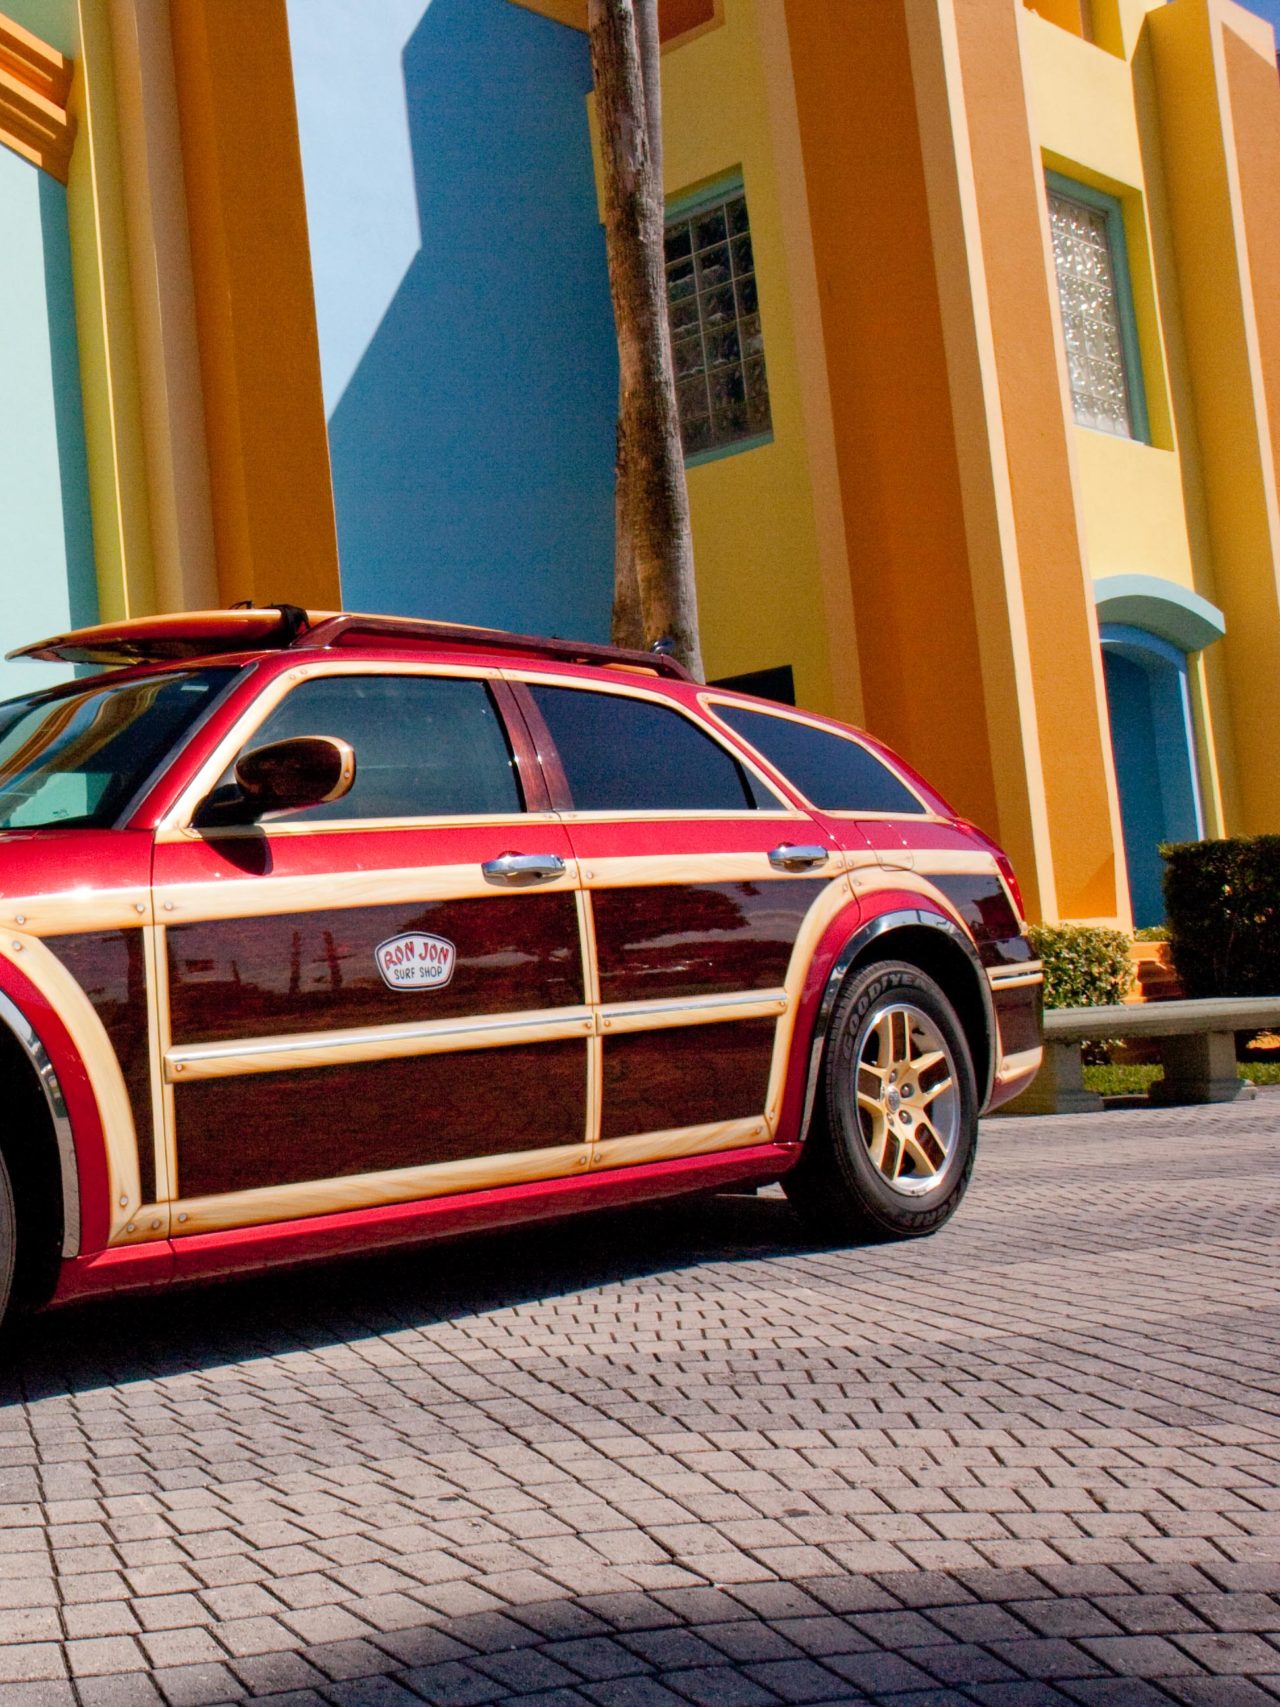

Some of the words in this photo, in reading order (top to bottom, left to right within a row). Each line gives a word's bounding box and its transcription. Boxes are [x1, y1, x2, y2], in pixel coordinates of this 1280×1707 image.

[384, 941, 414, 971] RON
[419, 942, 449, 965] JON
[393, 967, 415, 980] SURF
[419, 966, 443, 978] SHOP
